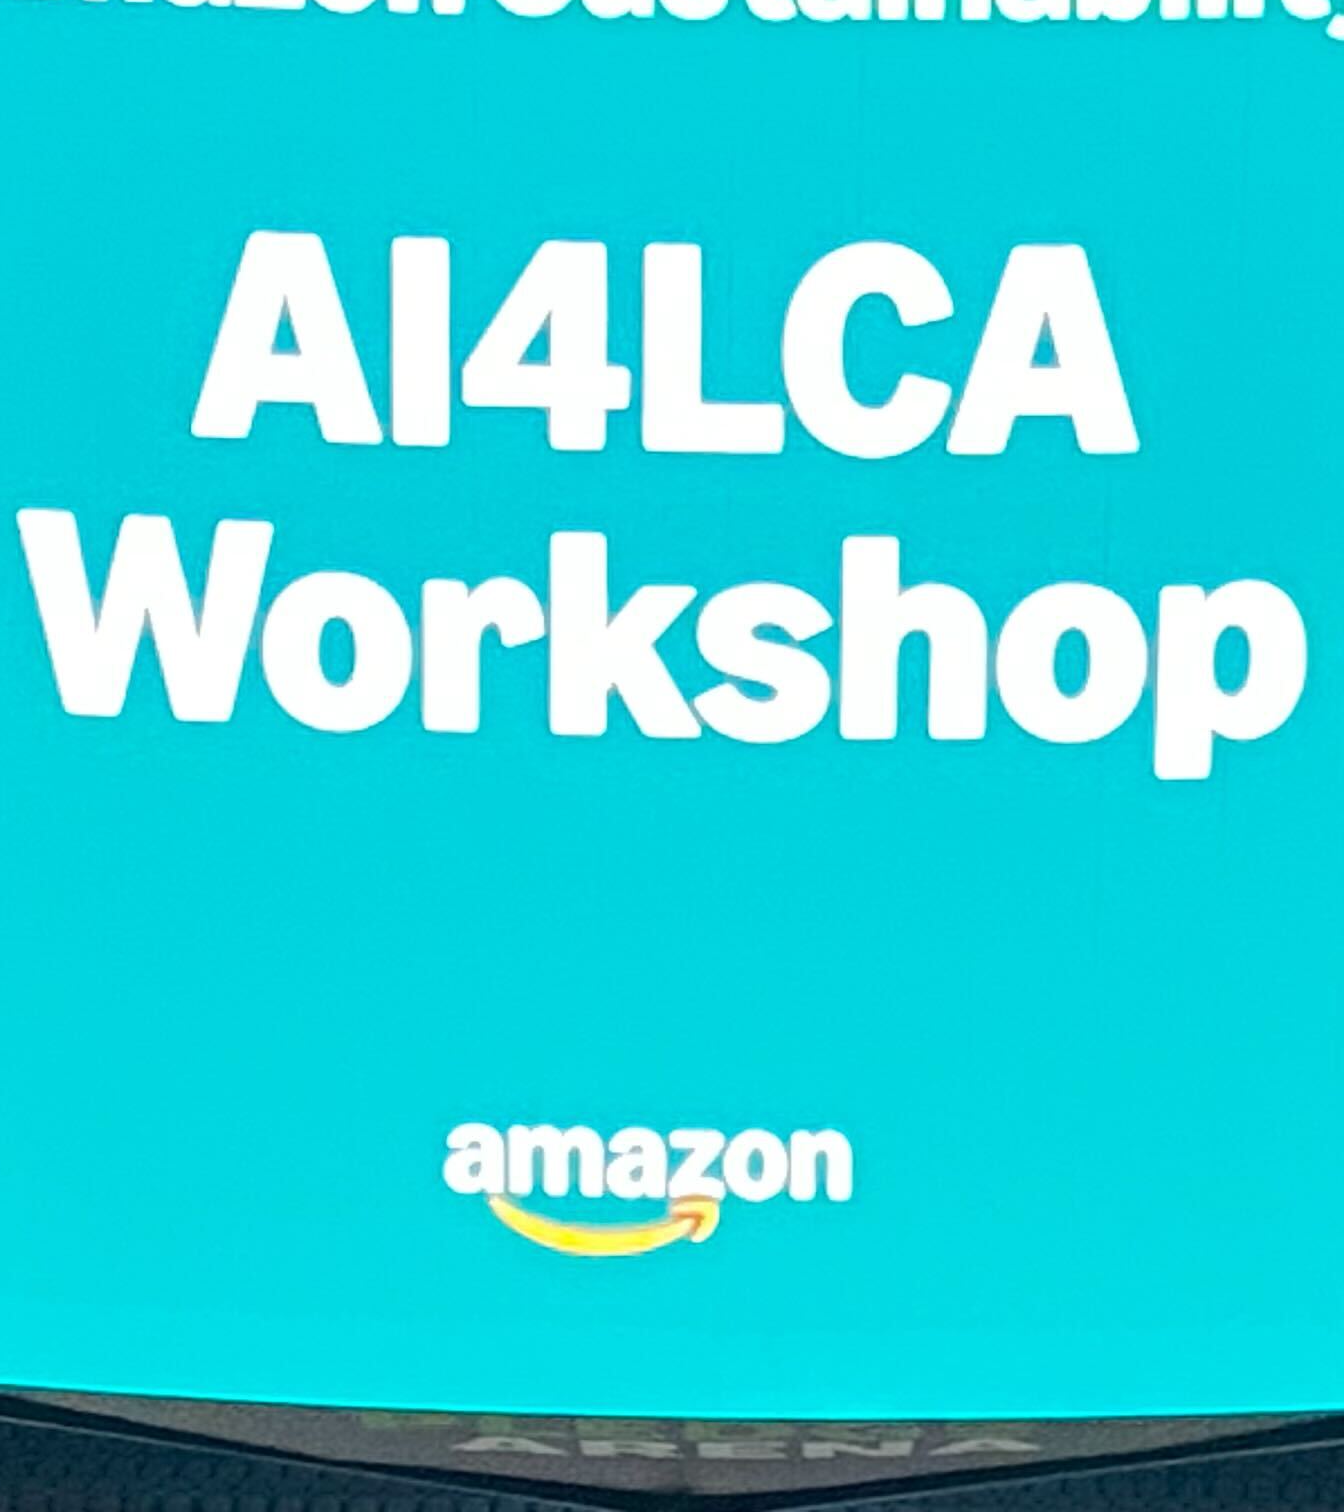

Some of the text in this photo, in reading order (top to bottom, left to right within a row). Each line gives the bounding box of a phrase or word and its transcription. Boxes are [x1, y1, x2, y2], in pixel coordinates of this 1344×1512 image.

[191, 229, 1142, 459] AI4LCA
[15, 507, 1309, 781] Workshop
[442, 1122, 854, 1202] amazon
[452, 1435, 1042, 1460] ARENA
